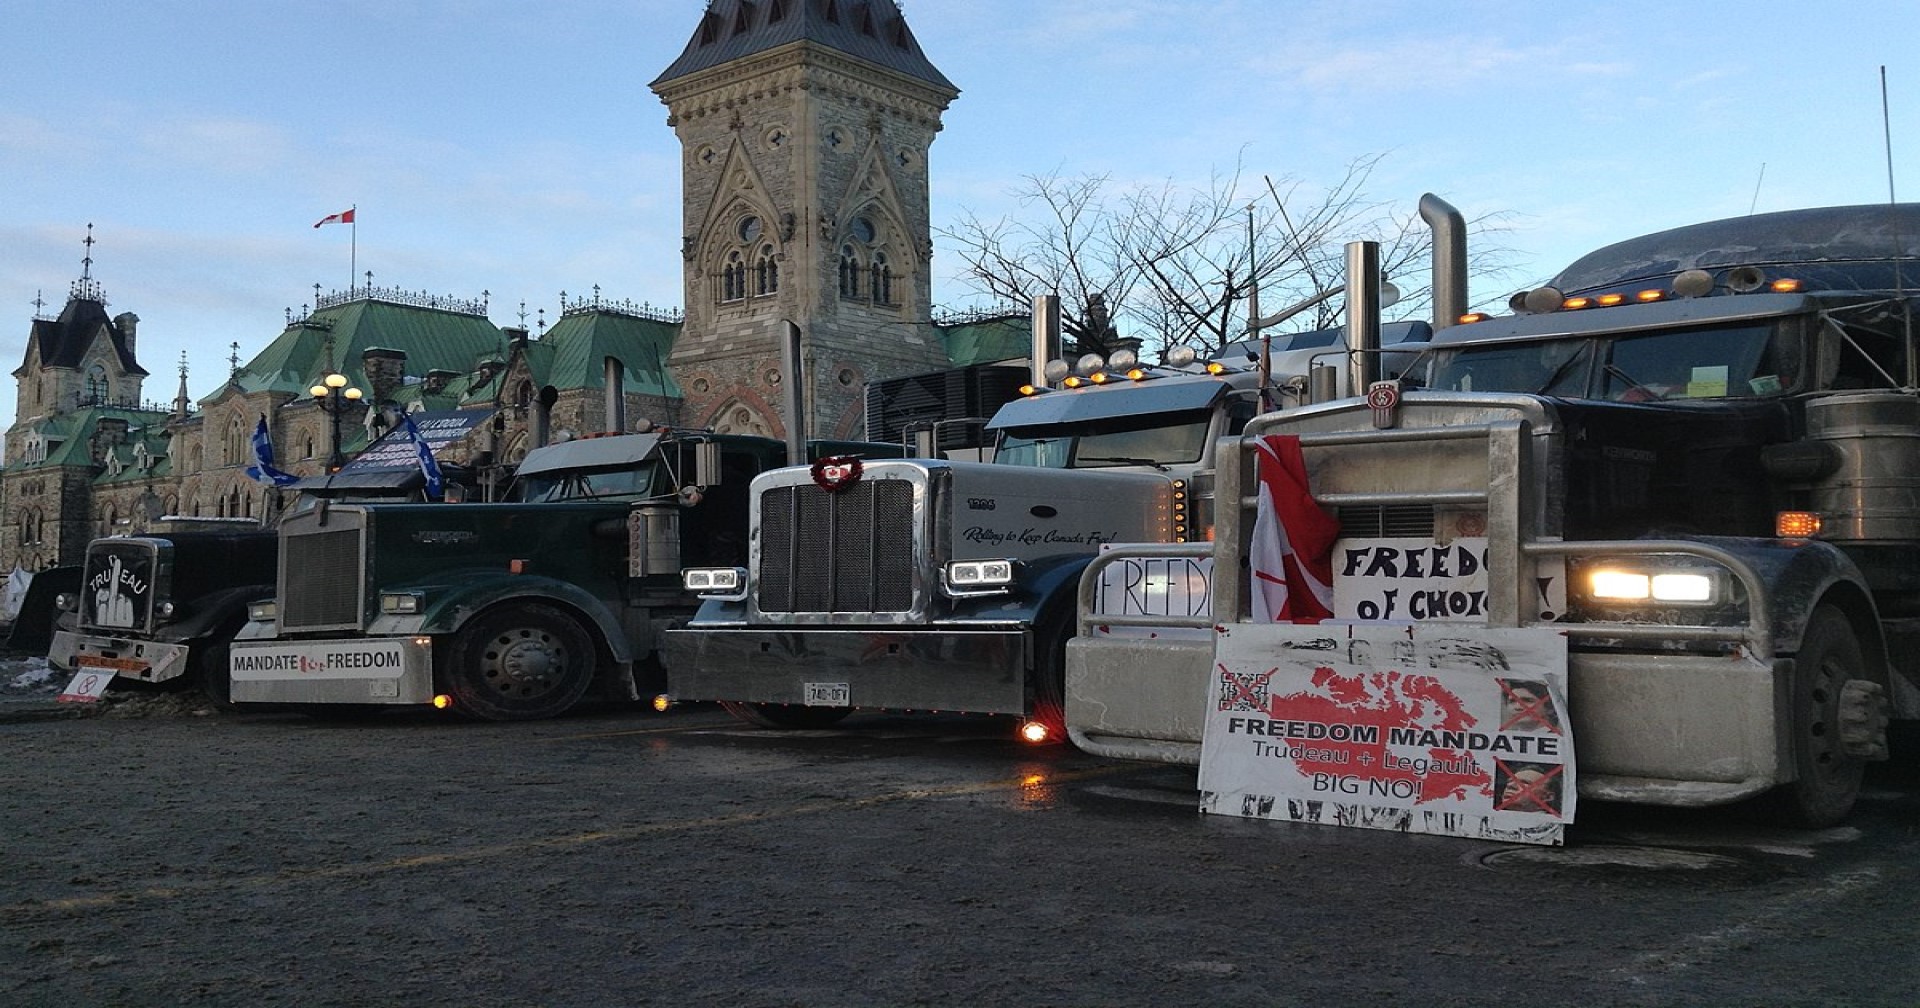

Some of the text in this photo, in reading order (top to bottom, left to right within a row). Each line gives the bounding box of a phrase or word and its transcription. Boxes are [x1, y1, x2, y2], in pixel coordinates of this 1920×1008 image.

[963, 527, 1004, 545] Rolling
[1006, 531, 1016, 541] to
[1018, 528, 1042, 545] Keep
[1043, 530, 1083, 544] Canada
[1342, 546, 1489, 578] FREED
[1102, 559, 1214, 616] FREED
[1409, 590, 1489, 619] CHOI
[234, 655, 298, 671] MANDATE
[327, 651, 401, 668] FREEDOM
[1228, 718, 1558, 756] FREEDOM MANDATE
[1253, 740, 1348, 764] Trudeau
[1384, 752, 1480, 776] Legault
[1313, 773, 1422, 800] BIG NO!
